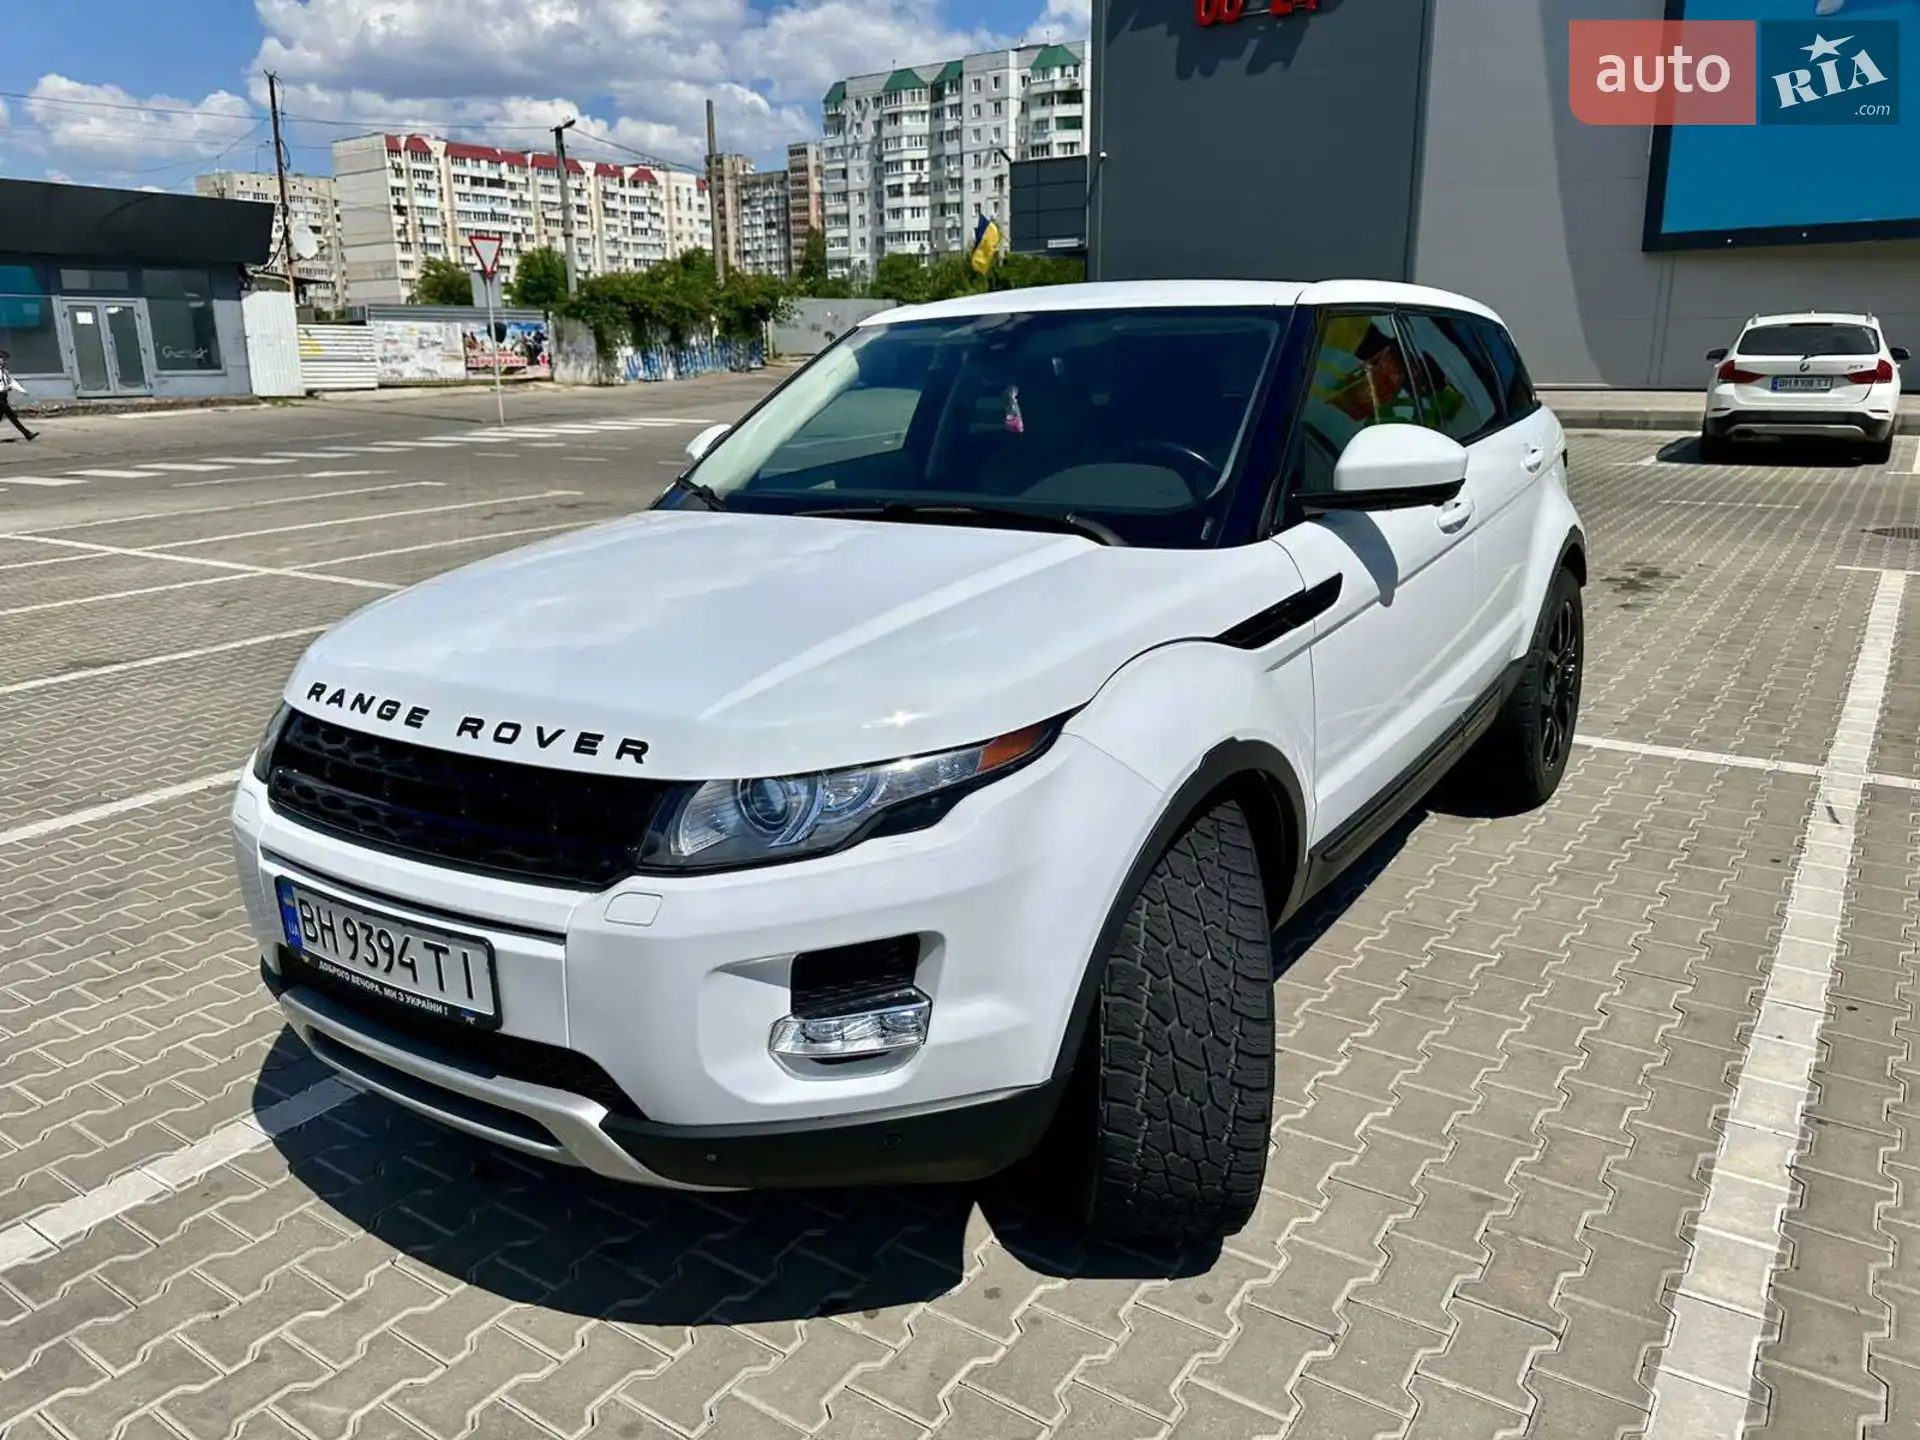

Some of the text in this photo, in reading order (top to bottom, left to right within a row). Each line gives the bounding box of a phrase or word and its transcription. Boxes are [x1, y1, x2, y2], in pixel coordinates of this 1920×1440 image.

[306, 682, 650, 765] RANGE ROVER
[298, 898, 339, 956] BH
[342, 916, 420, 985] 9394
